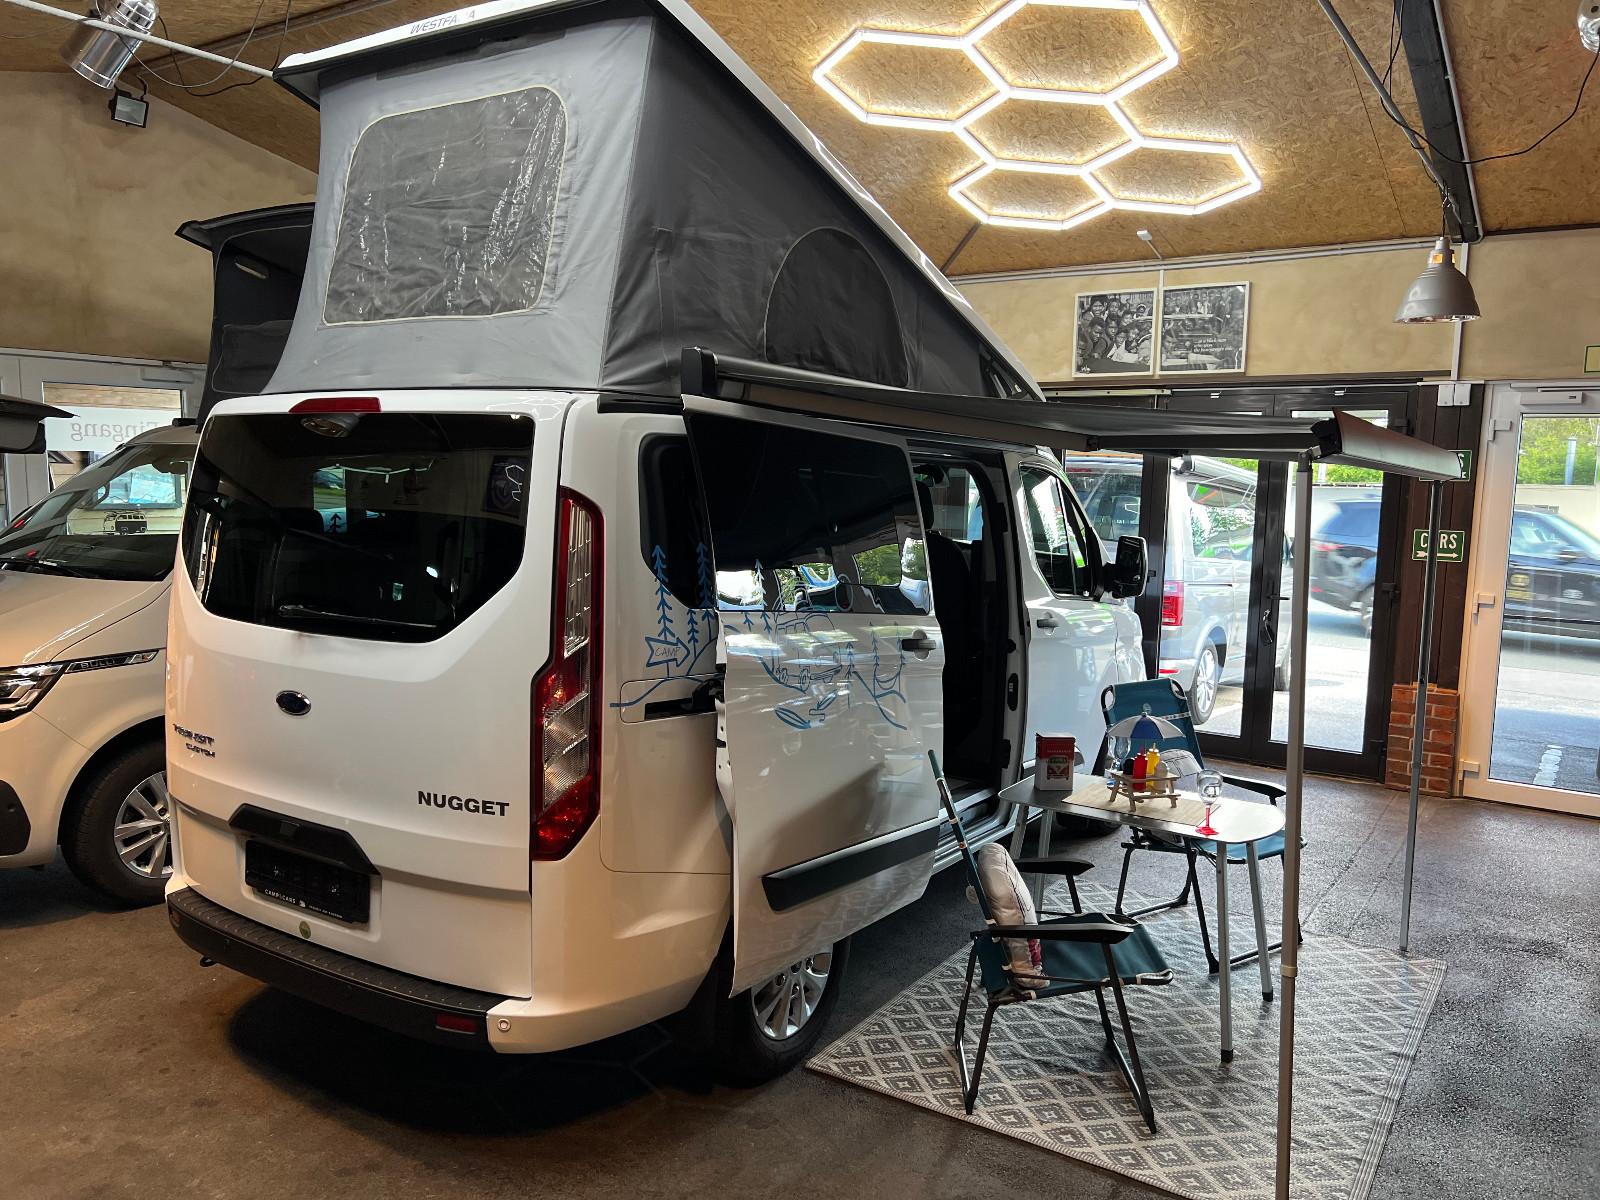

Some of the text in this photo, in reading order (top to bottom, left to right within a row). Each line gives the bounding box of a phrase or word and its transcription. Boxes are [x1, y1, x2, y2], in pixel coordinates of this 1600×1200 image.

[410, 10, 476, 34] WESTFAA
[1420, 533, 1457, 549] CRS
[655, 646, 681, 657] CAMP
[418, 791, 510, 816] NUGGET
